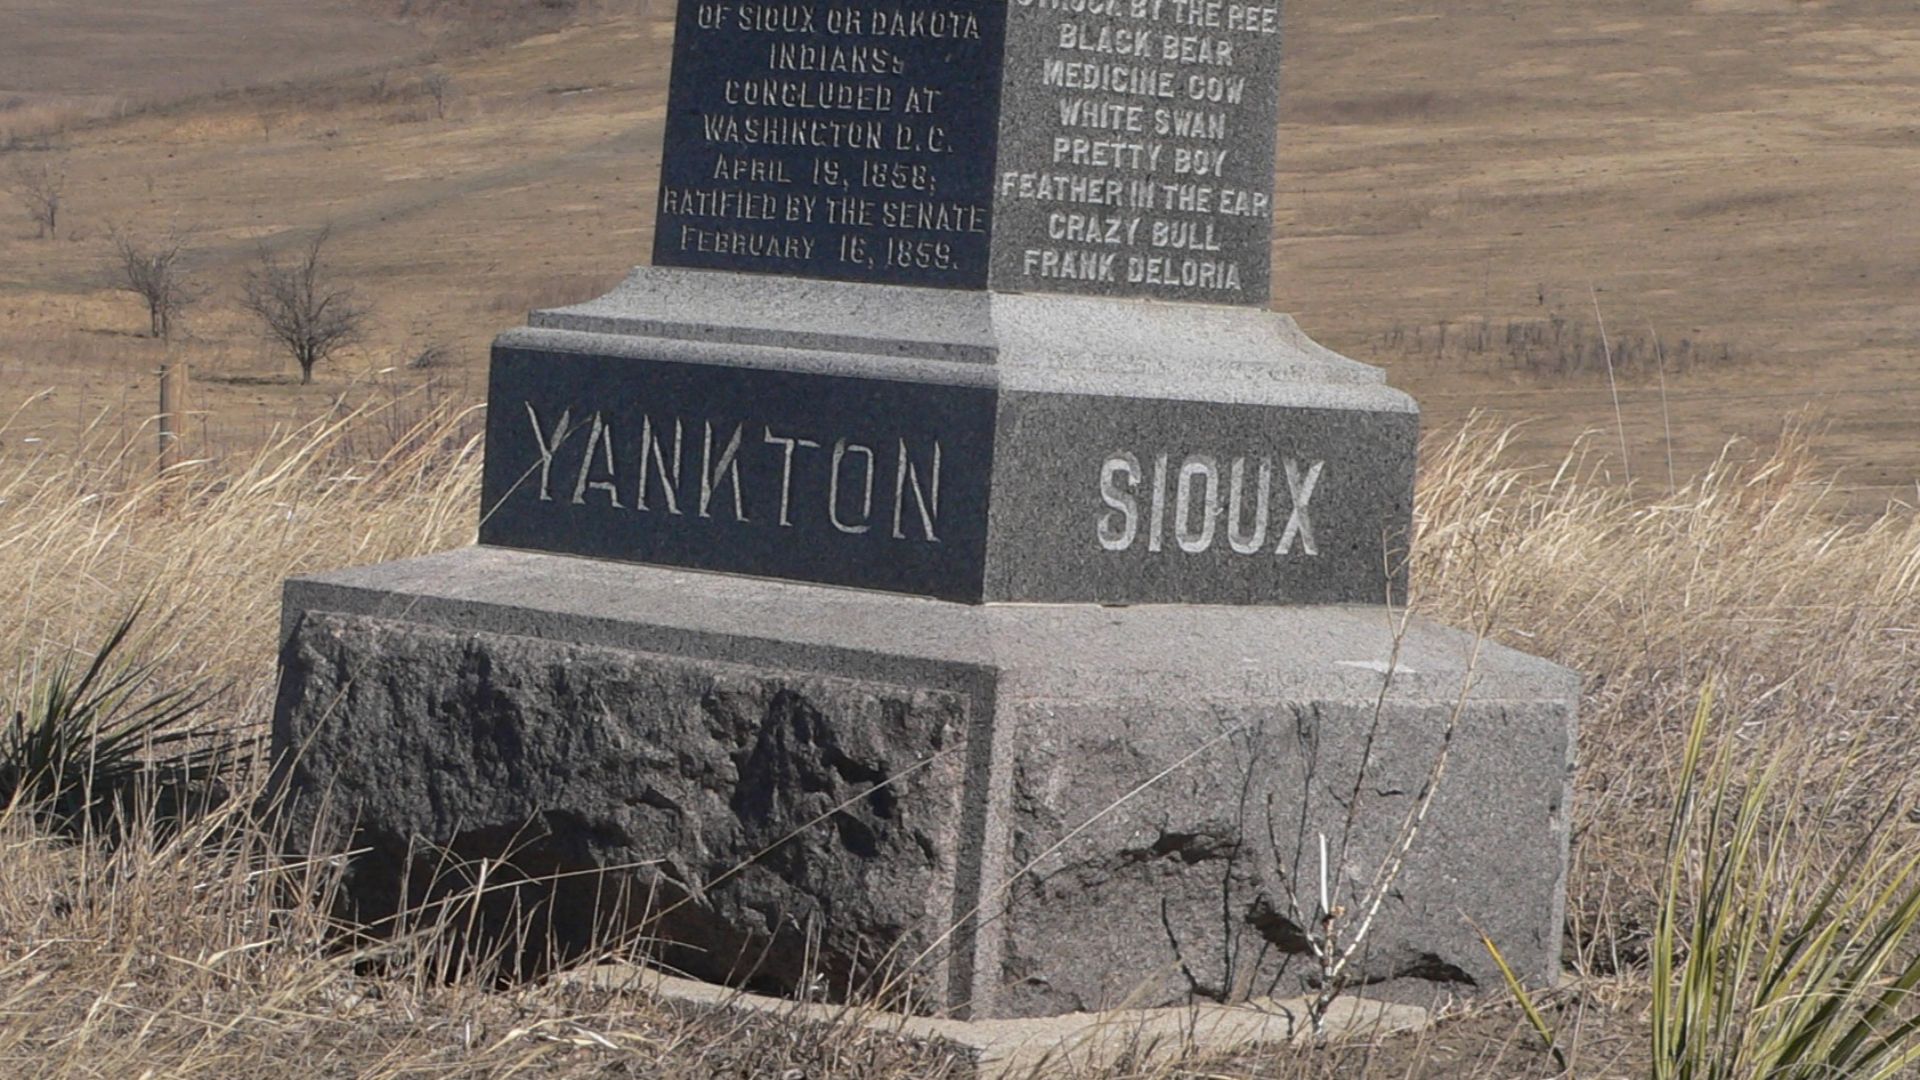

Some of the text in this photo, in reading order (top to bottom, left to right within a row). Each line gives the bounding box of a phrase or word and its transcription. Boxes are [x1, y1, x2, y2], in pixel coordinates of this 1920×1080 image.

[698, 3, 981, 40] OF SIOUX OR DAKOTA
[1173, 0, 1220, 27] THE
[1228, 4, 1278, 33] REE
[1059, 23, 1234, 66] BLACK BEAR
[725, 78, 942, 114] CONCLUDED AT
[1042, 58, 1246, 105] MEDICINE COW
[703, 113, 882, 150] WASHINGTON
[1059, 98, 1226, 140] WHITE SWAN
[713, 153, 792, 184] APRIL
[812, 157, 849, 192] 19,
[1053, 137, 1227, 177] PRETTY BOY
[662, 186, 989, 234] RATIFIED BY THE SENATE
[1001, 171, 1269, 218] FEATHER IN THE EAR
[680, 225, 816, 260] FEBRUARY
[1050, 213, 1221, 251] CRAZY BULL
[1023, 249, 1241, 291] FRANK DELORIA
[524, 400, 940, 543] YANKTON
[1097, 450, 1325, 558] SIOUX
